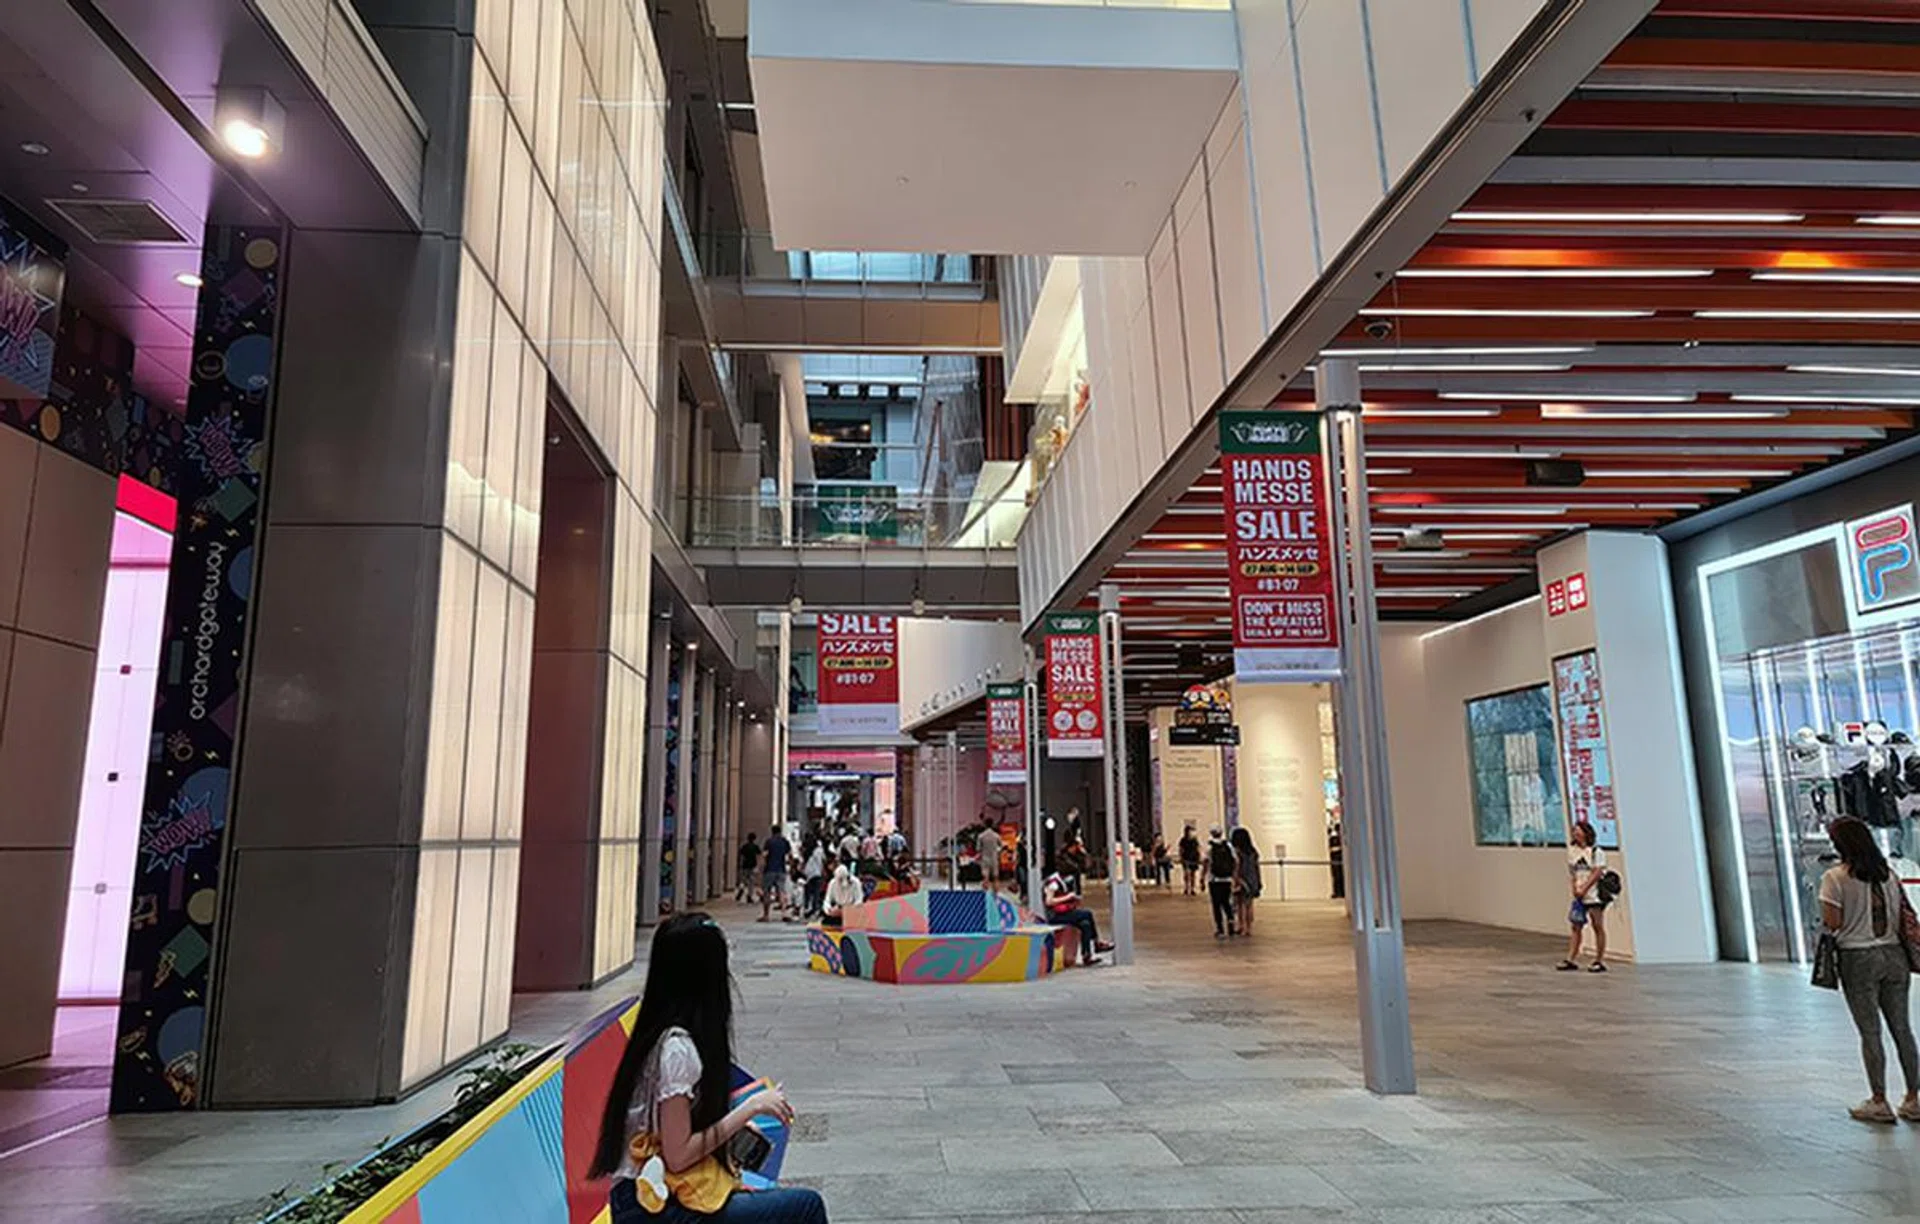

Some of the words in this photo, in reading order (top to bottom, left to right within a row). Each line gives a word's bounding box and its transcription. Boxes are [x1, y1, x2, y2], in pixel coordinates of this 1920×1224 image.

[1232, 459, 1312, 480] HANDS
[1234, 481, 1314, 503] MESSE
[1236, 510, 1317, 540] SALE
[1244, 601, 1285, 615] DON'T
[1286, 601, 1321, 615] MISS
[190, 541, 229, 720] orchardgateway
[822, 613, 894, 634] SALE
[1051, 637, 1093, 649] HANDS
[1051, 650, 1094, 663] MESSE
[1052, 665, 1095, 682] SALE
